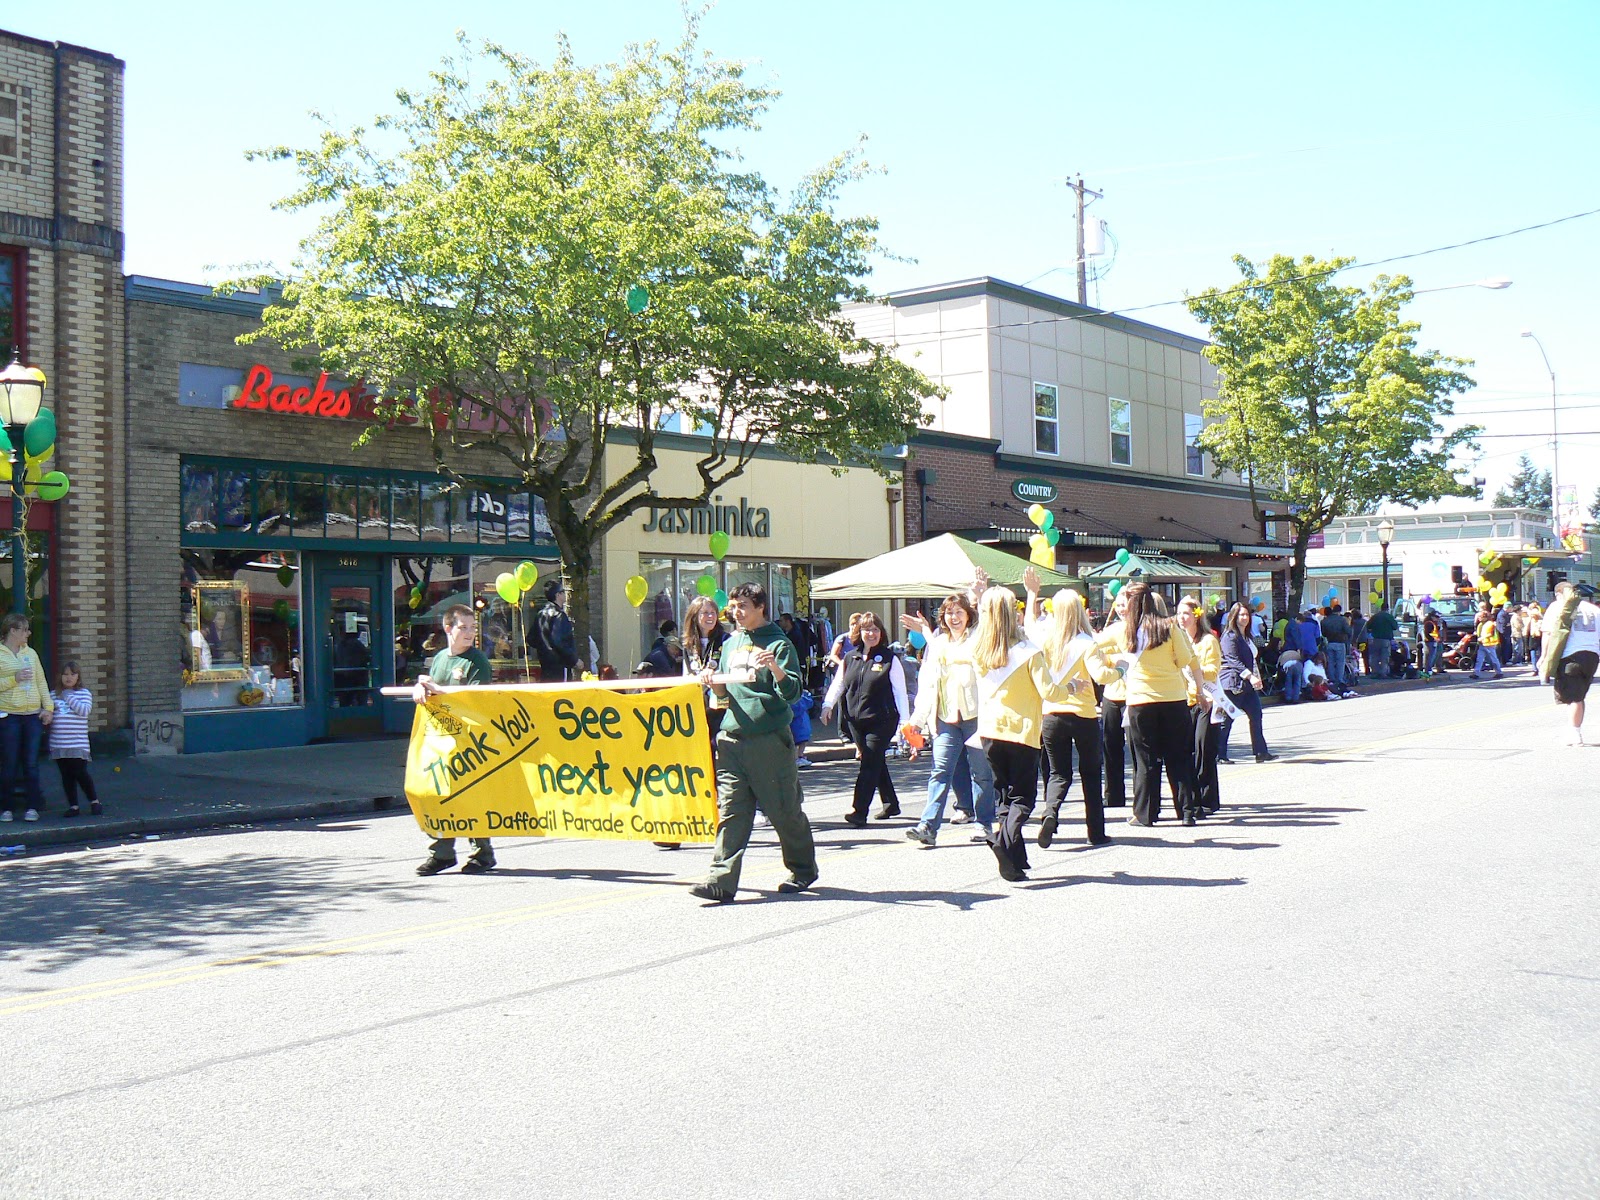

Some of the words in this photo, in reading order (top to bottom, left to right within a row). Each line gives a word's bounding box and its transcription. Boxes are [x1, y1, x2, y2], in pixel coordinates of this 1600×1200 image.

[643, 490, 770, 537] Jasminka
[1018, 483, 1052, 497] COUNTRY
[553, 699, 623, 741] See
[633, 703, 695, 751] you
[424, 732, 501, 796] Thank
[538, 750, 613, 795] next
[623, 763, 711, 808] year.
[424, 813, 479, 832] Junior
[486, 810, 558, 832] Daffodil
[563, 809, 624, 833] Parade
